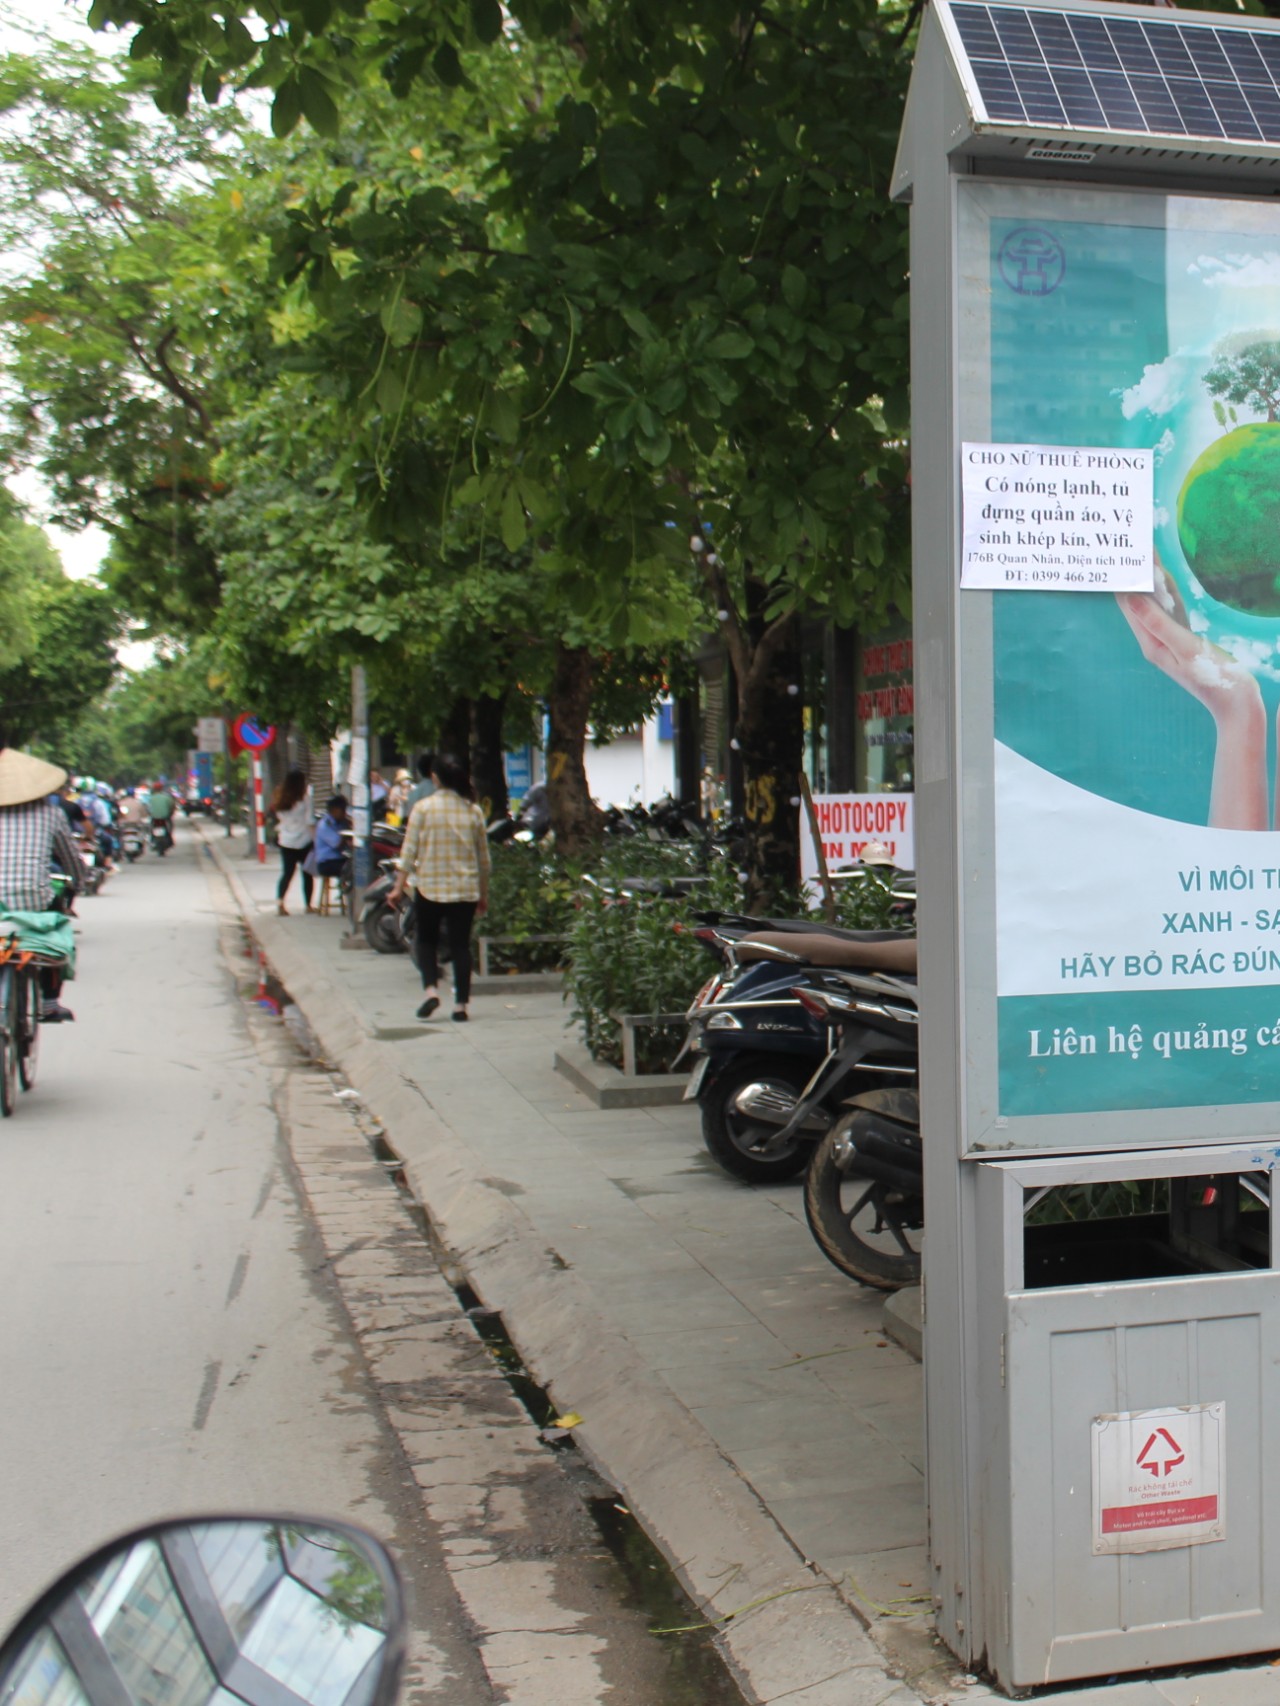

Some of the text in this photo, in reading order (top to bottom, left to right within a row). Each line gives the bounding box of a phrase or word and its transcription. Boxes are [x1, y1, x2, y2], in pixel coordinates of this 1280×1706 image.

[968, 450, 1145, 470] CHO NỮ THUÊ PHÒNG
[985, 476, 1130, 499] Có nóng lạnh, tủ
[981, 501, 1134, 527] đựng quần áo, Vệ
[979, 530, 1133, 549] sinh khép kín, Wifi.
[967, 552, 994, 563] 176B
[997, 553, 1028, 565] Quan
[1031, 553, 1064, 566] Nhân,
[1067, 554, 1093, 566] Diện
[1095, 555, 1116, 566] tích
[1005, 570, 1108, 583] ĐT: 0399 466 202
[1178, 866, 1201, 892] VÌ
[1210, 865, 1254, 891] MÔI
[1162, 911, 1232, 934] XANH
[1061, 953, 1115, 979] HÃY
[1124, 950, 1163, 976] BỎ
[1172, 948, 1225, 975] RÁC
[1027, 1027, 1097, 1057] Liên
[1108, 1024, 1142, 1059] hệ
[1153, 1022, 1248, 1059] quảng
